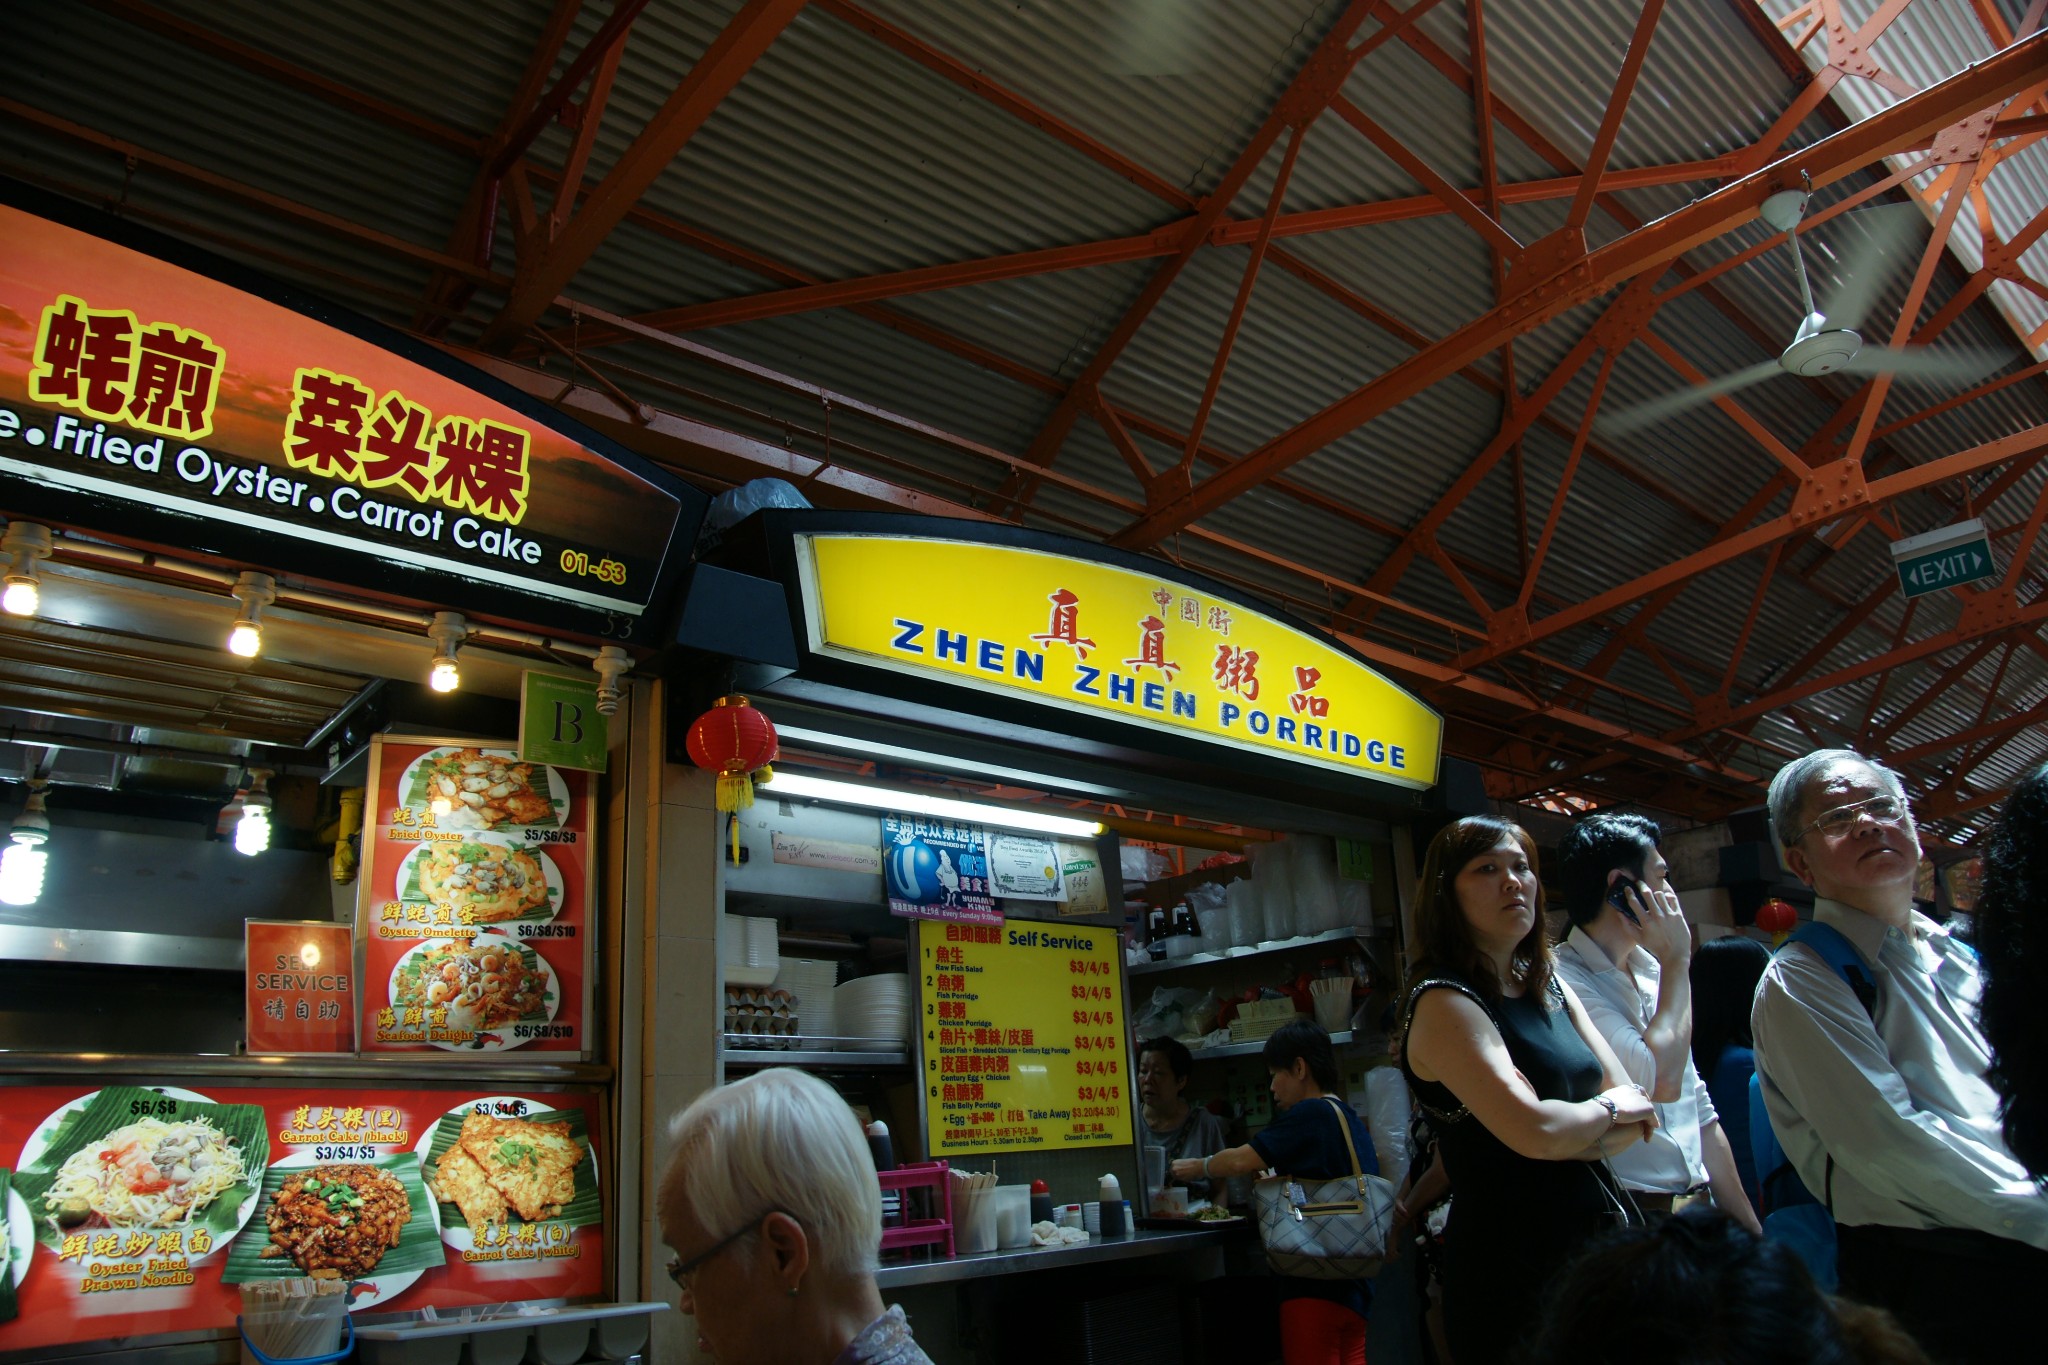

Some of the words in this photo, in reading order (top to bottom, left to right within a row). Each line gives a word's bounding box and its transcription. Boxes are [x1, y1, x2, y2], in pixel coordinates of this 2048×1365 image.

[30, 296, 224, 438] 蚝煎
[284, 368, 529, 522] 菜头粿
[53, 415, 163, 473] Fried
[176, 446, 307, 506] Oyster
[331, 487, 443, 541] Carrot
[453, 518, 542, 564] Cake
[560, 548, 626, 585] 01-53
[1920, 553, 1966, 585] EXIT
[1151, 586, 1233, 636] 中國街
[601, 614, 634, 639] 53
[1030, 587, 1330, 718] 真真粥品
[893, 617, 1044, 683] ZHEN
[1073, 665, 1196, 719] ZHEN
[1221, 701, 1406, 769] PORRIDGE
[550, 700, 583, 744] B
[392, 806, 438, 829] 蚝煎
[388, 828, 420, 840] Fried
[424, 830, 463, 842] Oyster
[524, 828, 576, 843] $5/$6/$8
[923, 838, 960, 849] RECOMMENDED
[962, 895, 995, 906] YUMMY
[968, 903, 991, 913] KING
[943, 909, 958, 919] Every
[960, 912, 980, 921] Sunday
[982, 912, 1002, 923] 9:00pm
[379, 926, 420, 938] Oyster
[423, 926, 477, 938] Omelette
[518, 924, 576, 938] $6/$8/$10
[946, 923, 1002, 945] 自助服務
[1008, 930, 1037, 947] Self
[1041, 933, 1093, 950] Service
[936, 946, 964, 964] 魚生
[935, 963, 949, 972] Raw
[950, 964, 964, 972] Fish
[965, 965, 983, 973] Salad
[1070, 959, 1110, 976] $3/4/5
[256, 974, 348, 992] SERVICE
[926, 976, 933, 986] 2
[937, 973, 965, 992] 魚粥
[936, 992, 950, 1000] Fish
[951, 992, 979, 1000] Porridge
[1071, 985, 1111, 1001] $3/4/5
[264, 997, 341, 1021] 请自助
[927, 1004, 934, 1015] 3
[938, 1019, 964, 1027] Chicken
[965, 1019, 992, 1027] Porridge
[1073, 1010, 1113, 1027] $3/4/5
[377, 1030, 425, 1042] Seafood
[429, 1031, 474, 1044] Delight
[514, 1025, 573, 1038] $6/$8/$10
[928, 1030, 934, 1040] 4
[1075, 1036, 1115, 1053] $3/4/5
[930, 1060, 936, 1070] 5
[1076, 1061, 1117, 1077] $3/4/5
[941, 1074, 966, 1082] Century
[967, 1074, 979, 1082] Egg
[931, 1086, 937, 1097] 6
[1078, 1086, 1119, 1103] $3/4/5
[130, 1100, 177, 1115] $6/$8
[475, 1102, 528, 1116] $3/$4/$5
[942, 1102, 956, 1110] Fish
[957, 1101, 973, 1110] Belly
[974, 1101, 1001, 1110] Porridge
[949, 1114, 965, 1126] Egg
[1028, 1109, 1047, 1120] Take
[1049, 1109, 1070, 1120] Away
[279, 1130, 326, 1144] Carrot
[328, 1130, 360, 1143] Cake
[363, 1130, 409, 1145] (black)
[942, 1140, 969, 1148] Business
[1064, 1133, 1082, 1141] Closed
[1091, 1132, 1113, 1140] Tuesday
[315, 1146, 376, 1160] $3/$4/$5
[462, 1248, 502, 1262] Carrot
[504, 1247, 534, 1260] Cake
[537, 1245, 580, 1261] (white)
[90, 1262, 142, 1278] Oyster
[148, 1258, 188, 1273] Fried
[80, 1277, 136, 1293] Prawn
[142, 1272, 194, 1286] Noodle
